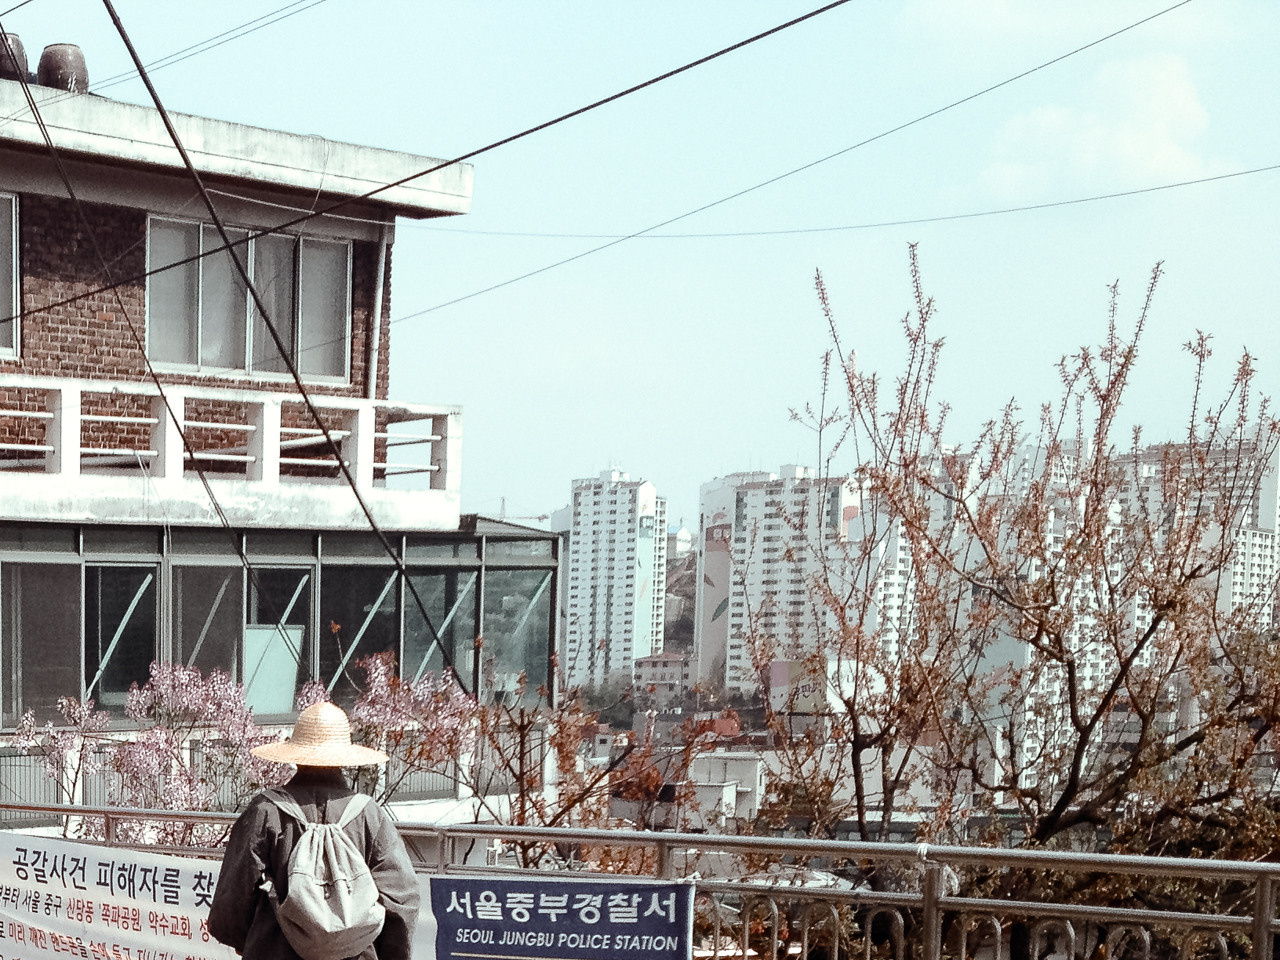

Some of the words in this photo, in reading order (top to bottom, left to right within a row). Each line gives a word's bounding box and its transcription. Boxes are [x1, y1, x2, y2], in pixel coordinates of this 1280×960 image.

[12, 847, 87, 890] 공갈사건
[96, 861, 181, 905] 피해자를
[22, 889, 40, 913] 서울
[44, 893, 62, 917] 중구
[66, 898, 94, 924] 신당동
[446, 891, 676, 924] 서울중부경찰서
[8, 922, 26, 946] 미리
[456, 928, 495, 945] SEOUL
[499, 931, 554, 947] JUNGBU
[558, 934, 611, 949] POLICE
[614, 936, 678, 951] STATION
